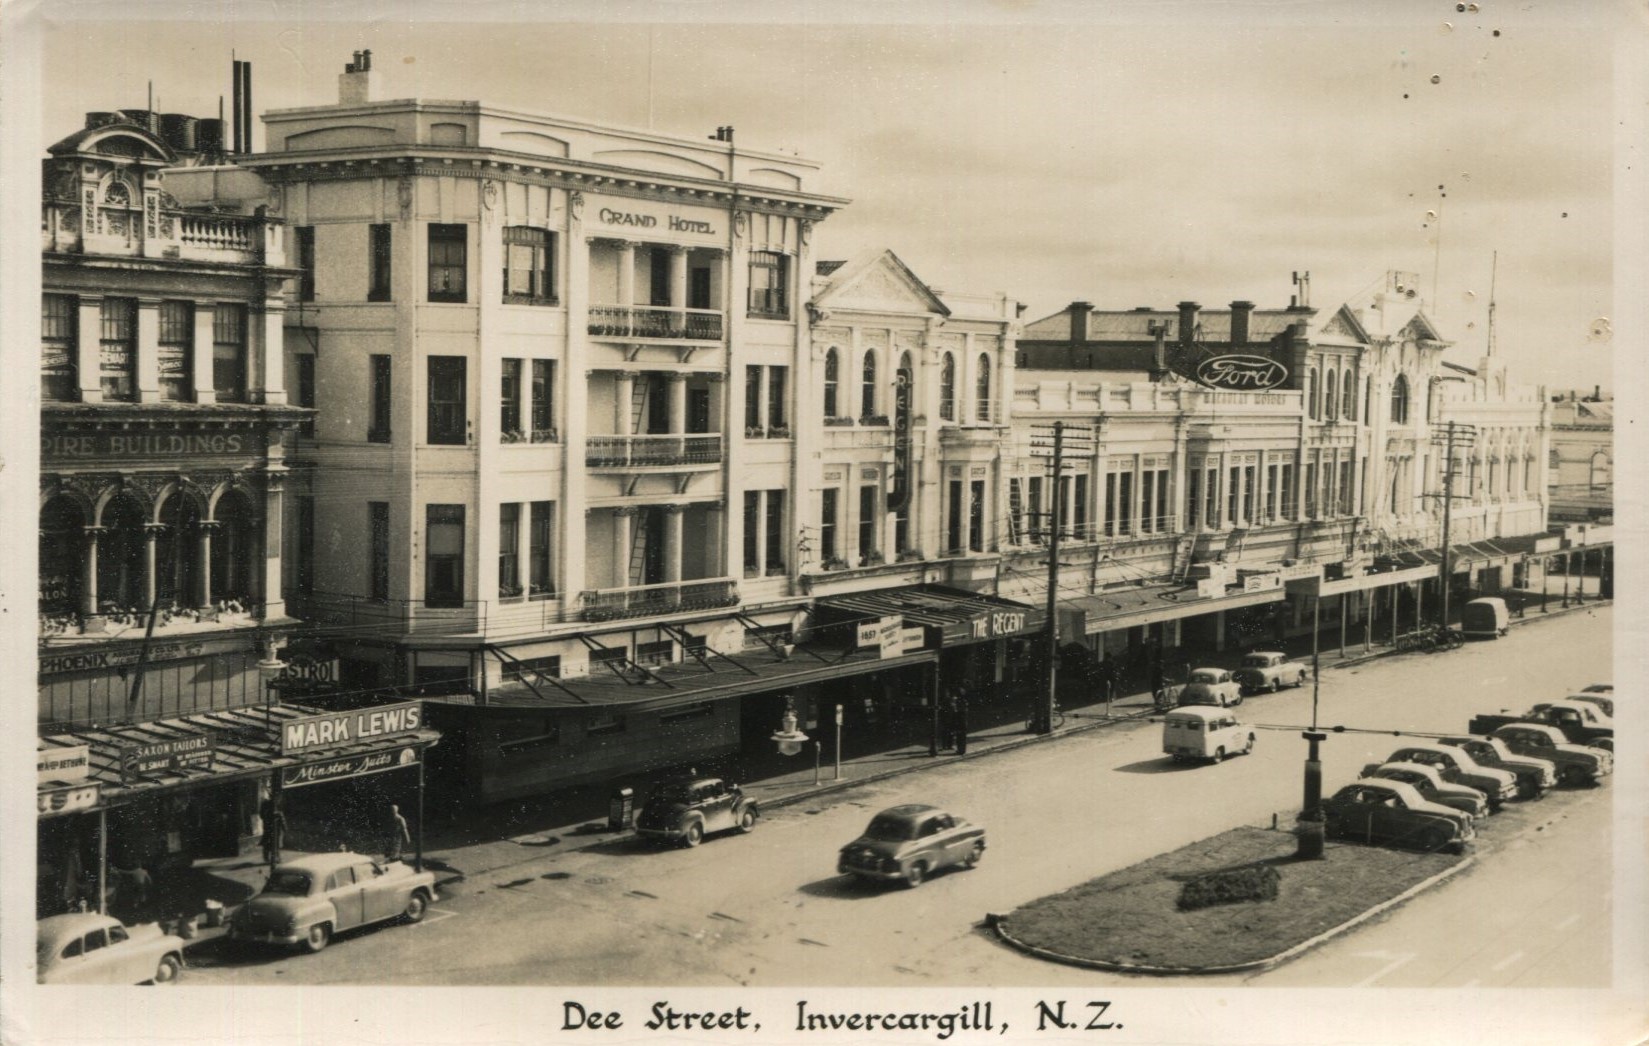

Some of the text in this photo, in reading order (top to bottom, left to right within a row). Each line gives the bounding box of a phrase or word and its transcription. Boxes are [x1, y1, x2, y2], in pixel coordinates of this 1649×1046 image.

[599, 207, 716, 235] GRAND HOTEL
[1203, 360, 1276, 386] Ford
[109, 434, 242, 454] BUILDINGS
[895, 374, 907, 491] REGENT
[972, 613, 1026, 639] THE REGENT
[40, 655, 108, 672] PHOENIX
[272, 659, 339, 686] ASTROL
[287, 706, 419, 749] MARK LEWIS
[136, 737, 208, 758] SAXON TAILORS
[285, 754, 392, 785] Minster Suits
